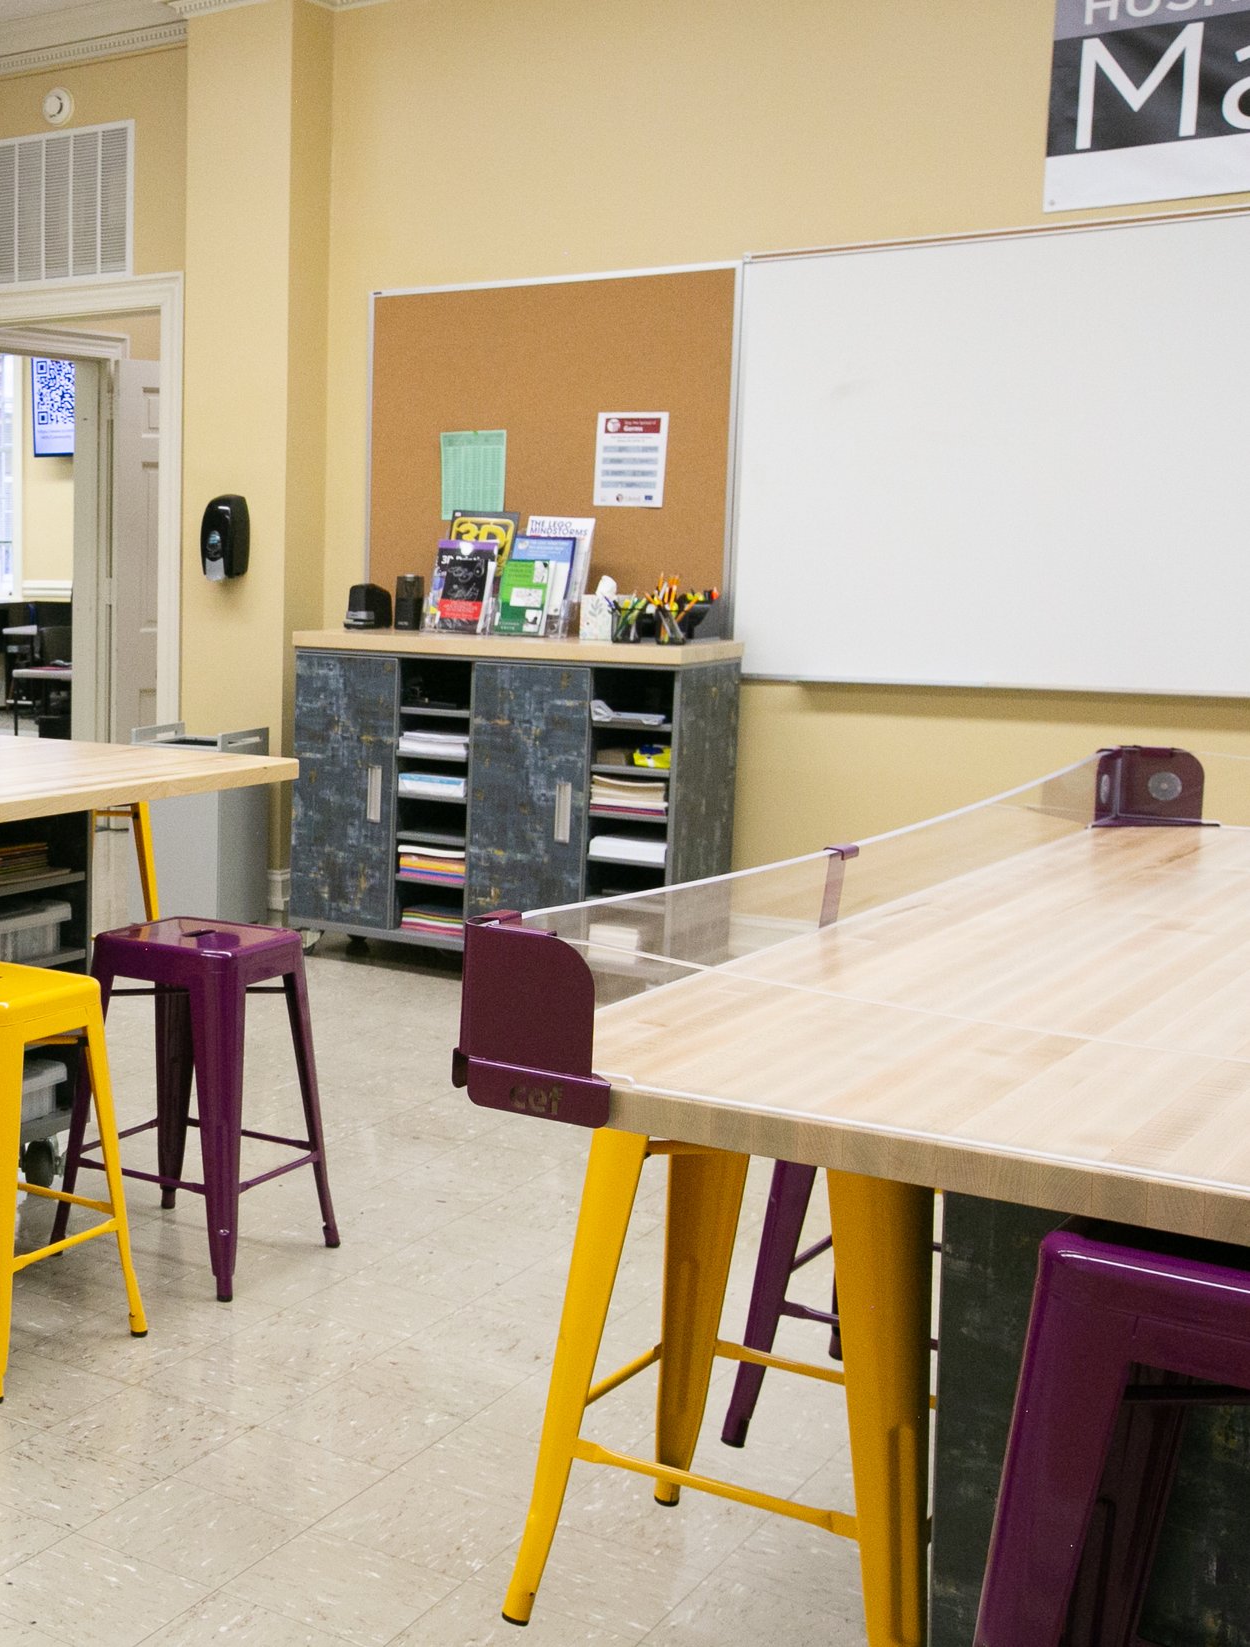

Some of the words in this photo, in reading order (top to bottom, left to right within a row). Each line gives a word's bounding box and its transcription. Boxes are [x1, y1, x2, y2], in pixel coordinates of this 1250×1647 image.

[531, 519, 545, 528] THE
[548, 520, 572, 529] LEGO
[530, 527, 589, 537] MINDSTORMS
